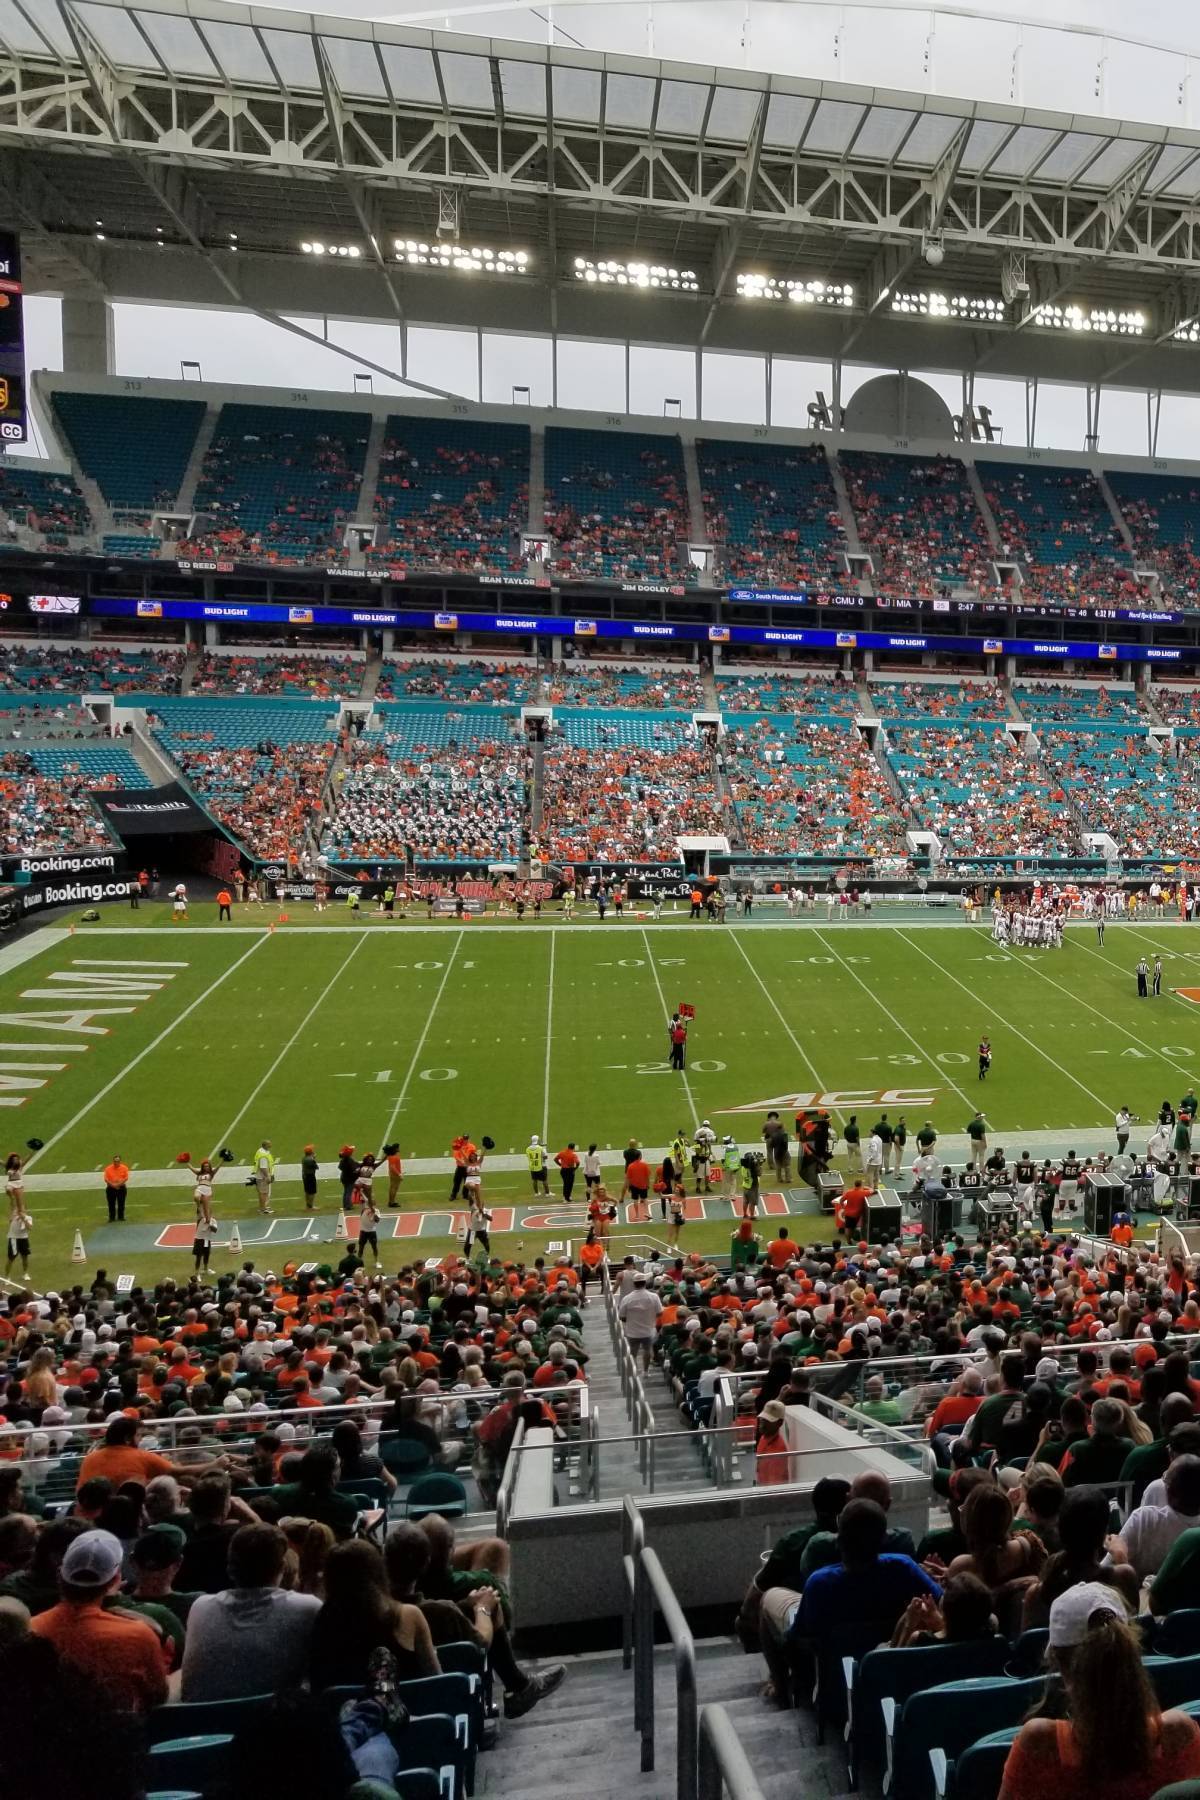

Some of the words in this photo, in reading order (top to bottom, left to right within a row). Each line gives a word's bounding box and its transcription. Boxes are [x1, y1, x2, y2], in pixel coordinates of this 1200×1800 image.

[124, 382, 142, 391] 313
[291, 393, 308, 402] 314
[452, 404, 468, 414] 315
[327, 569, 365, 577] WARREN
[503, 578, 535, 586] TAYLOR
[835, 597, 855, 605] CMU
[858, 598, 864, 606] 0
[896, 599, 912, 607] MIA
[958, 603, 974, 611] 2:47
[204, 607, 222, 615] BUD
[223, 608, 249, 616] LIGHT
[353, 613, 371, 621] BUD
[372, 614, 396, 622] LIGHT
[496, 619, 513, 627] BUD
[514, 620, 537, 628] LIGHT
[651, 627, 673, 635] LIGHT
[766, 632, 781, 640] BUD
[782, 633, 803, 641] LIGHT
[906, 639, 926, 647] LIGHT
[21, 856, 114, 874] Booking.com
[617, 957, 688, 968] 20
[809, 955, 873, 965] 30
[985, 953, 1046, 963] 40
[1119, 1046, 1196, 1059] 40
[888, 1052, 971, 1066] 30
[636, 1059, 727, 1075] 20
[364, 1067, 459, 1084] 10
[710, 1088, 942, 1114] ACC
[710, 1168, 721, 1180] 20
[1020, 1167, 1031, 1177] 71
[965, 1175, 977, 1185] 60
